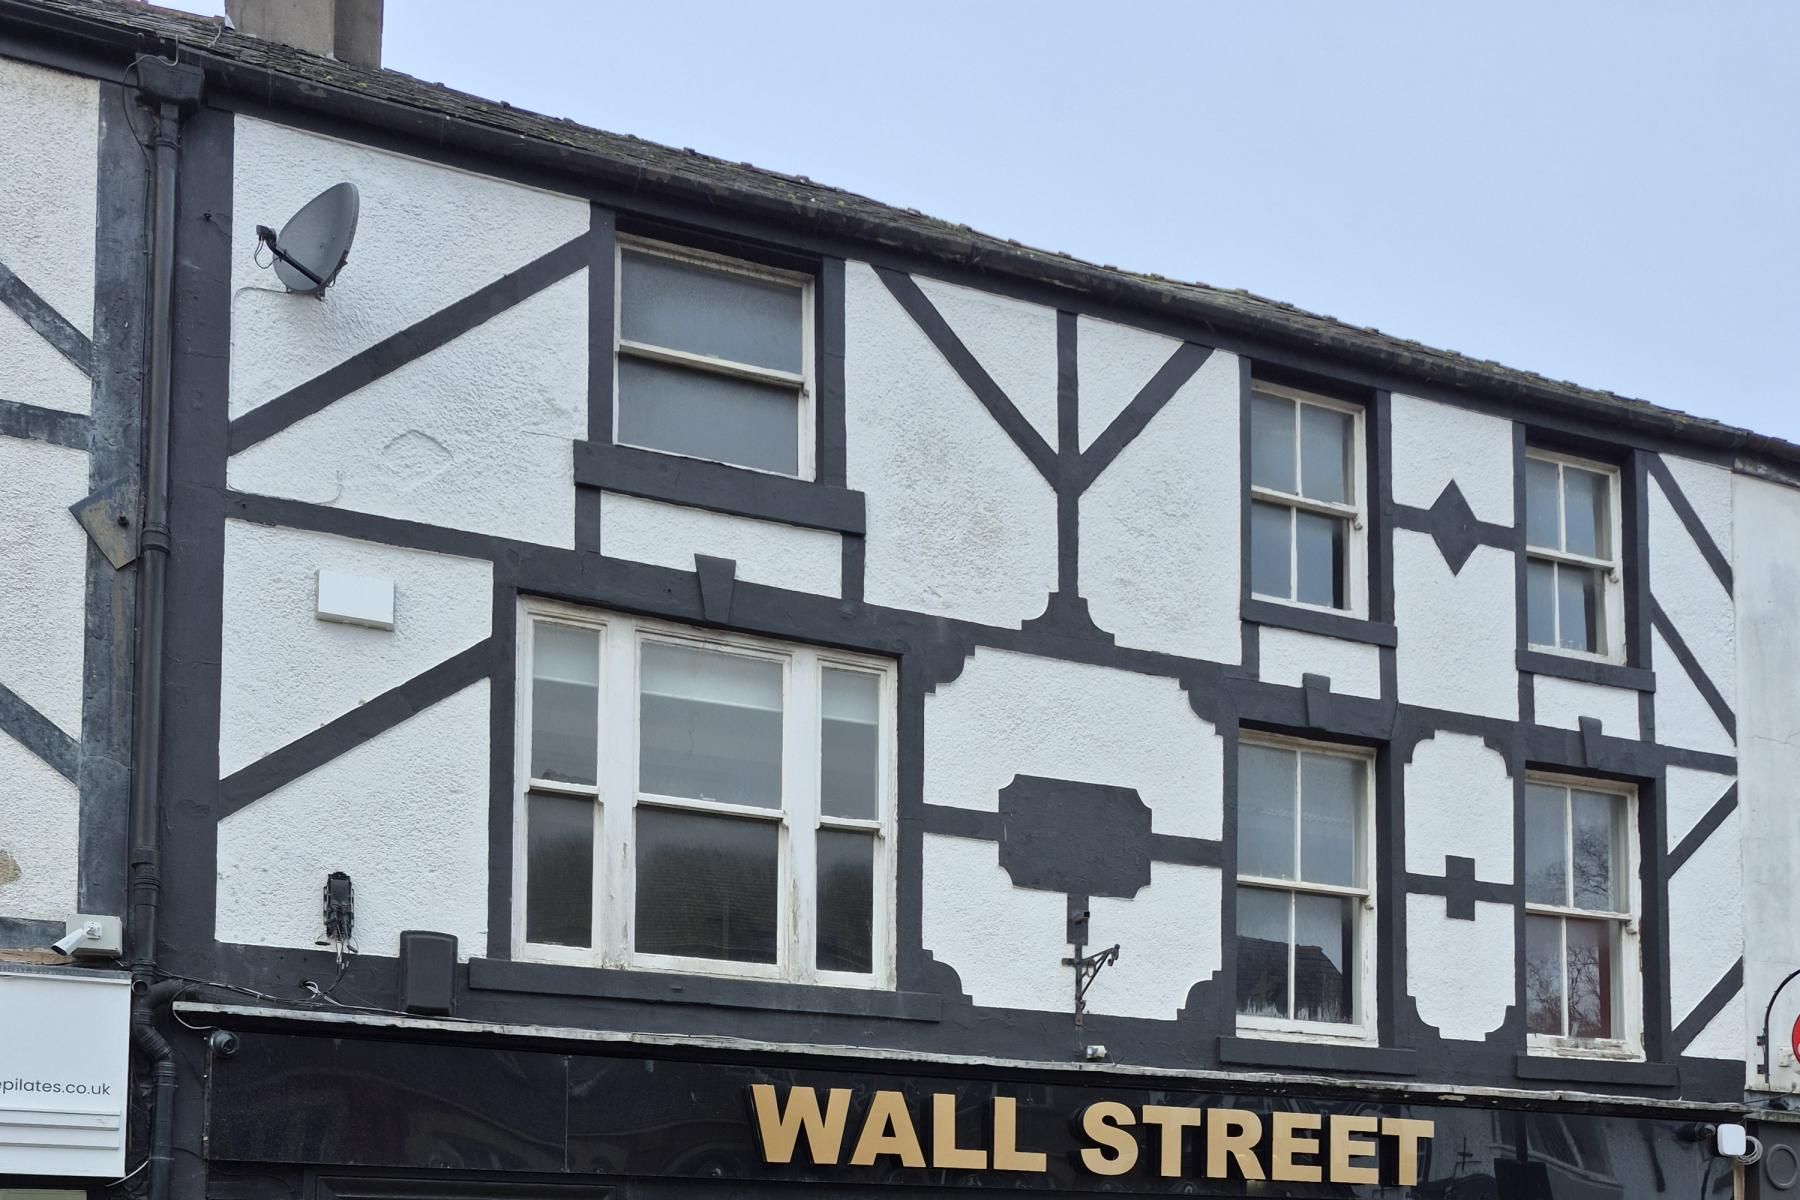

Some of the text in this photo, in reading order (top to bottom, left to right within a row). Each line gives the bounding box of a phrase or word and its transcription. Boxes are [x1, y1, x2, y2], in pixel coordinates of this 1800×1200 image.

[0, 1078, 110, 1095] pilates.co.uk
[752, 1084, 1435, 1187] WALL STREET
